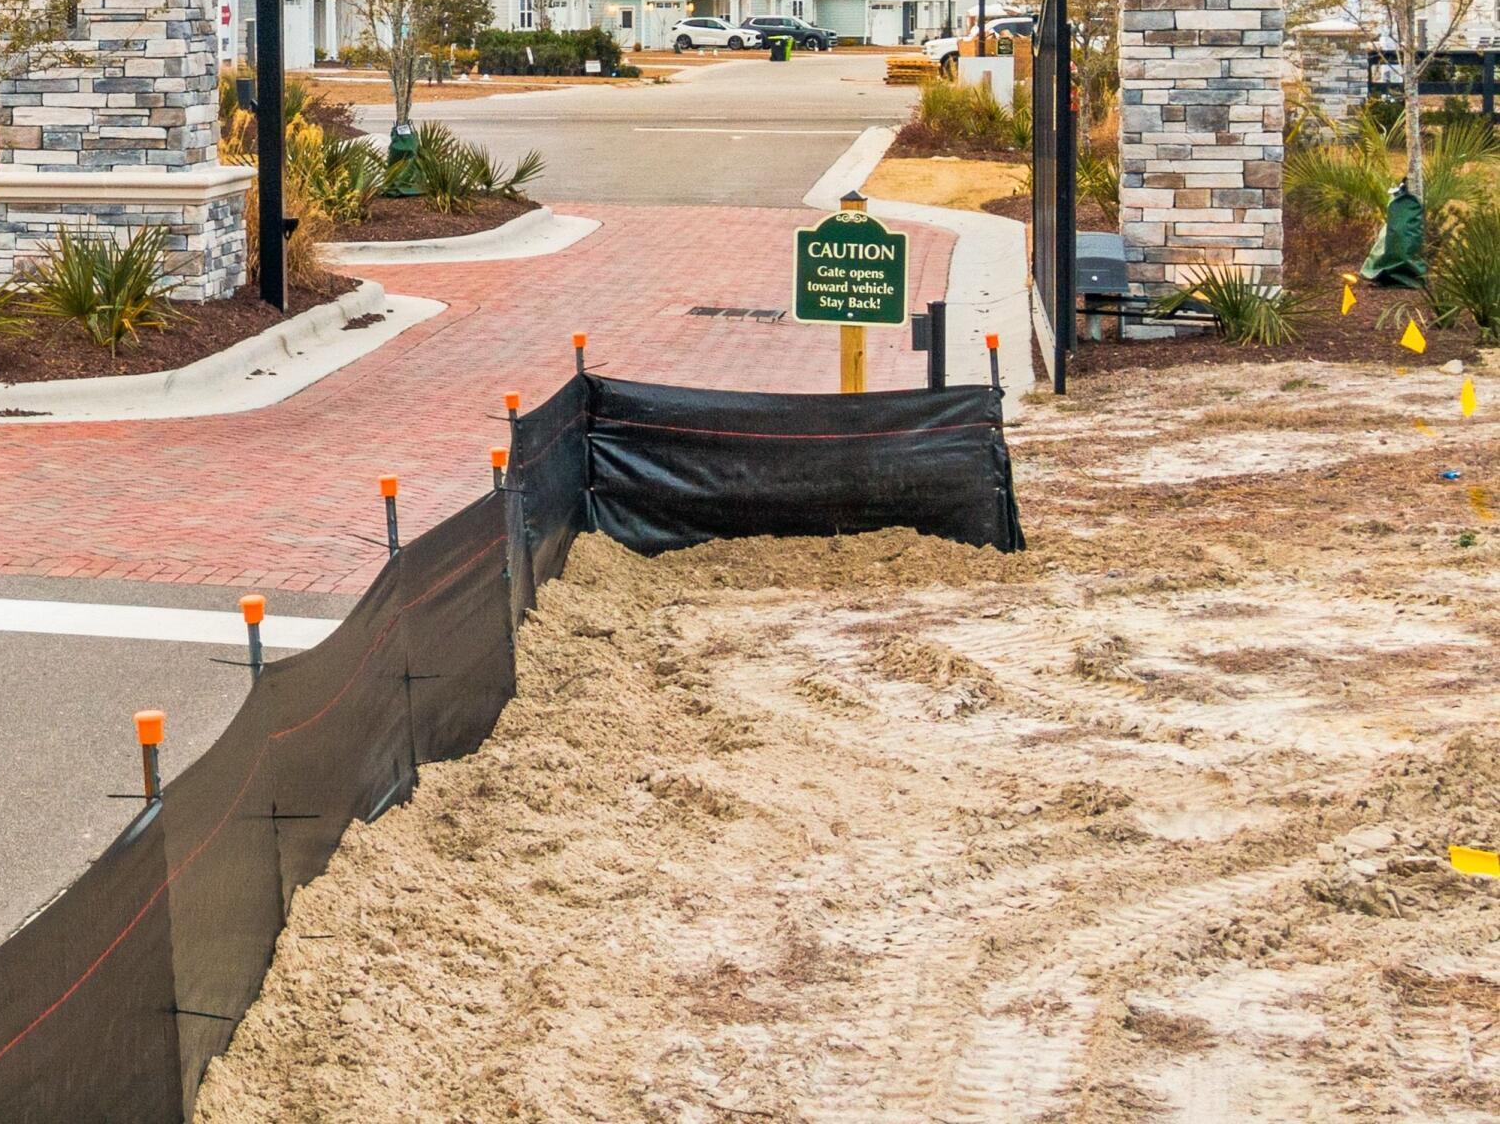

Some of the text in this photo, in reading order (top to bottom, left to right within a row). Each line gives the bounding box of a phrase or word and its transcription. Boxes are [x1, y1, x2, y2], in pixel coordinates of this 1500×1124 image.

[808, 242, 895, 260] CAUTION
[817, 266, 885, 281] Gate opens
[807, 281, 895, 295] toward vehicle
[819, 296, 881, 311] Stay Back!
